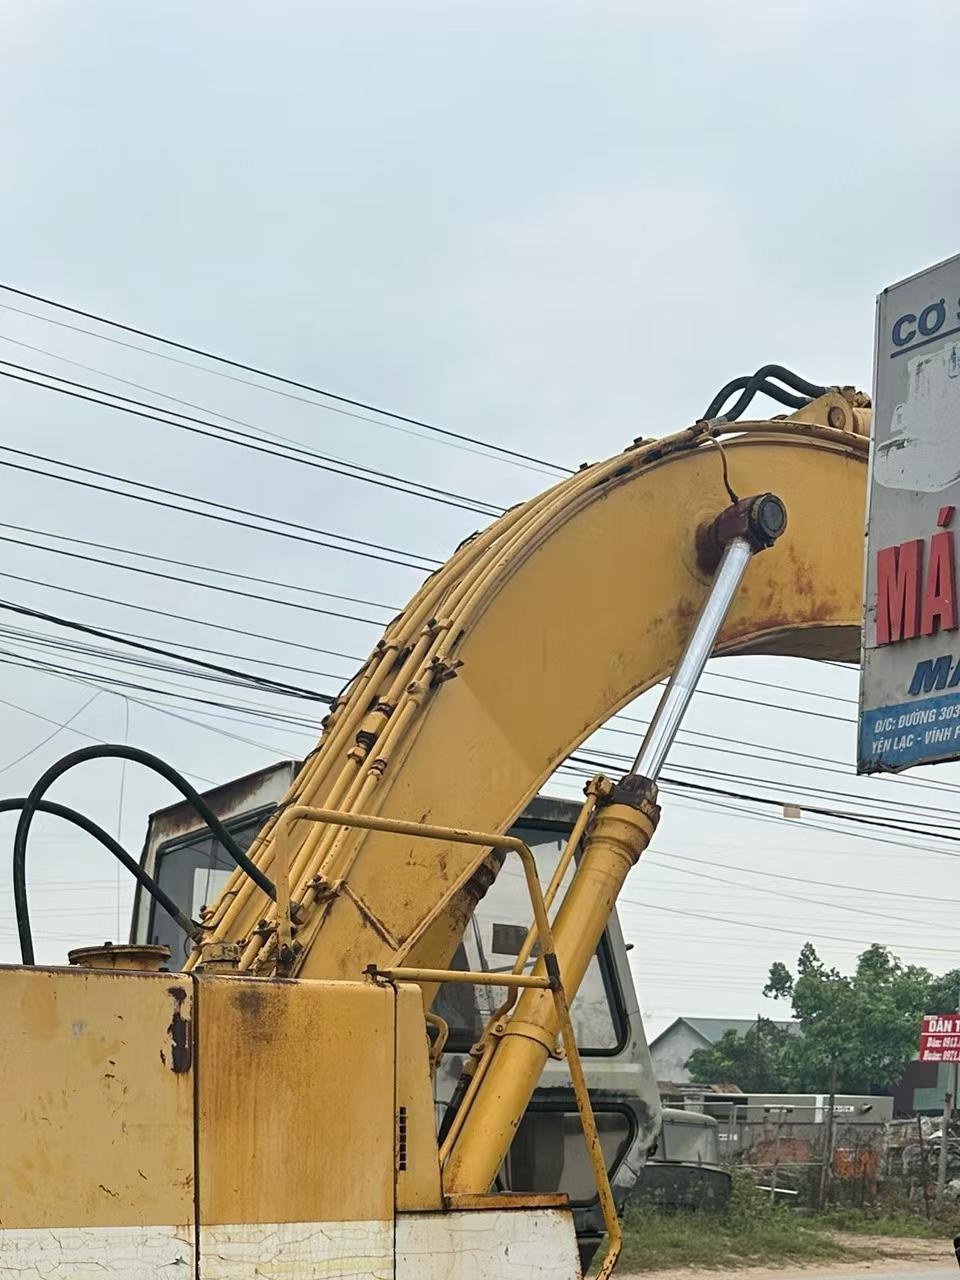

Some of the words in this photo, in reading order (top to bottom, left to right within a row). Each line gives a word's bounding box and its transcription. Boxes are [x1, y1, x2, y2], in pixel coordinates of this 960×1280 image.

[892, 298, 946, 347] CƠ
[871, 737, 892, 754] YÊN
[893, 734, 914, 753] LẠC
